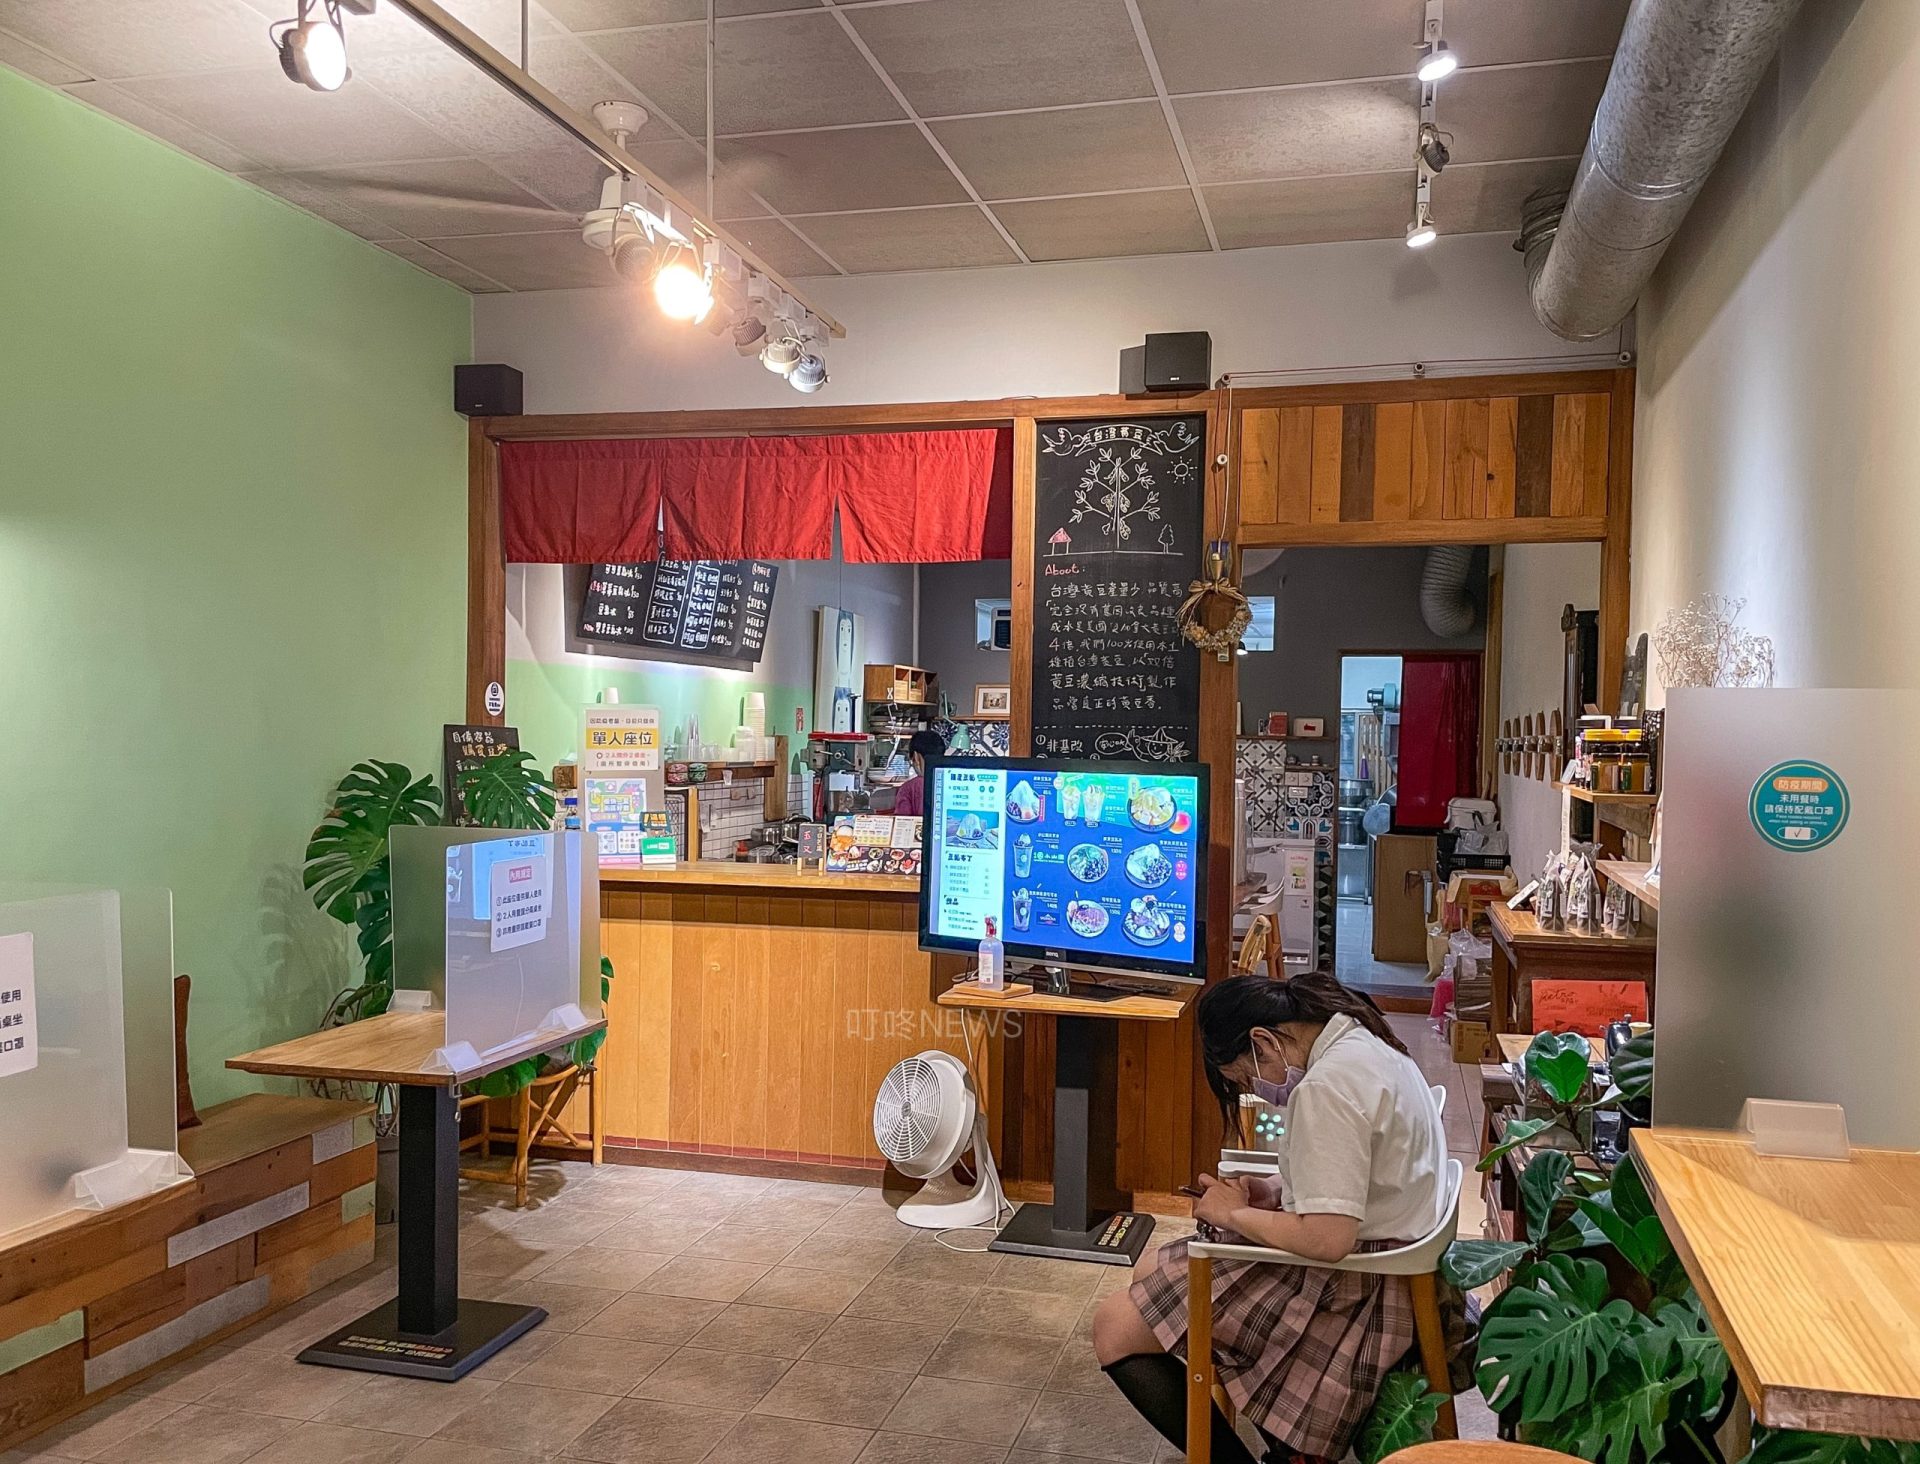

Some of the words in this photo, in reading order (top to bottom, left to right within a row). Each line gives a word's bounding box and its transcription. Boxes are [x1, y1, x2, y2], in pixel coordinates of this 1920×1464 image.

[592, 731, 653, 746] 單人座位
[1778, 779, 1823, 791] 防疫期間
[1780, 794, 1820, 804] 未用餐時
[0, 1013, 24, 1029] 桌坐
